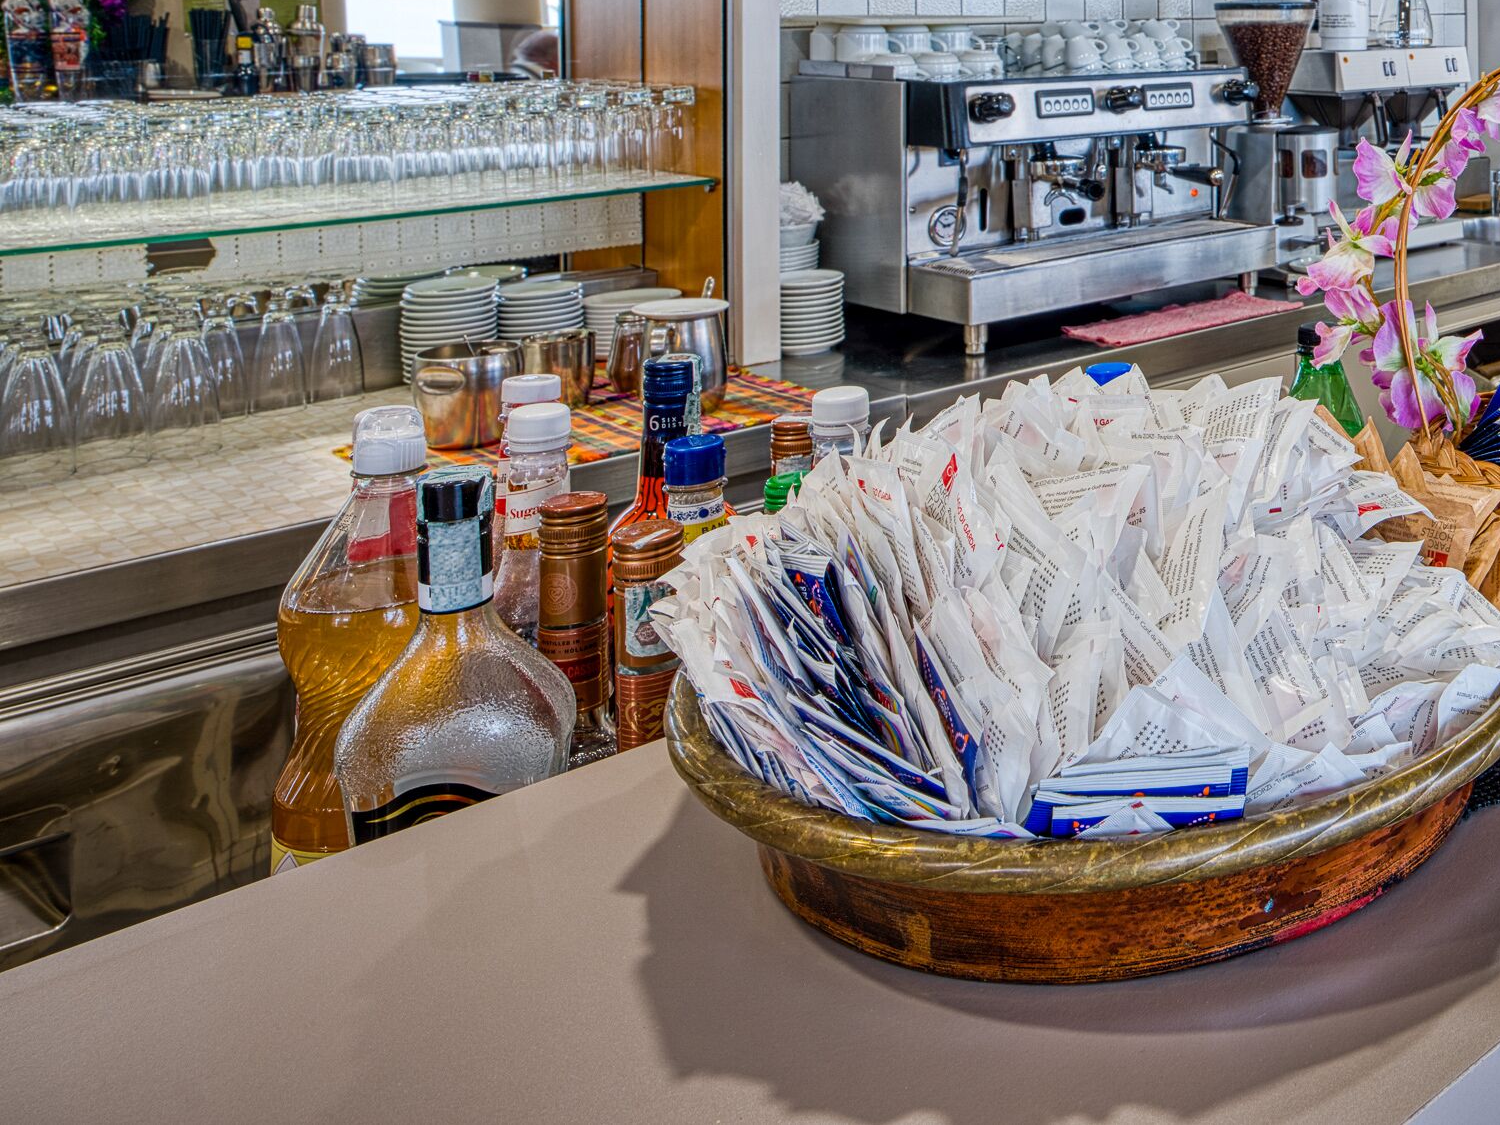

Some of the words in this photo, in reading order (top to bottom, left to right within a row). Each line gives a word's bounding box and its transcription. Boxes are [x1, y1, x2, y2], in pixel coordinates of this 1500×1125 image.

[649, 414, 660, 431] 6
[1420, 526, 1456, 543] HOTELS
[1427, 538, 1450, 552] PARC
[1222, 555, 1240, 572] Resort
[1127, 638, 1142, 655] Hotel
[1197, 643, 1207, 663] Palace
[1210, 654, 1222, 676] Antares
[1217, 675, 1228, 695] Hotel
[1384, 696, 1400, 712] Resort
[1303, 774, 1324, 787] Resort
[1251, 786, 1273, 803] ZORZI
